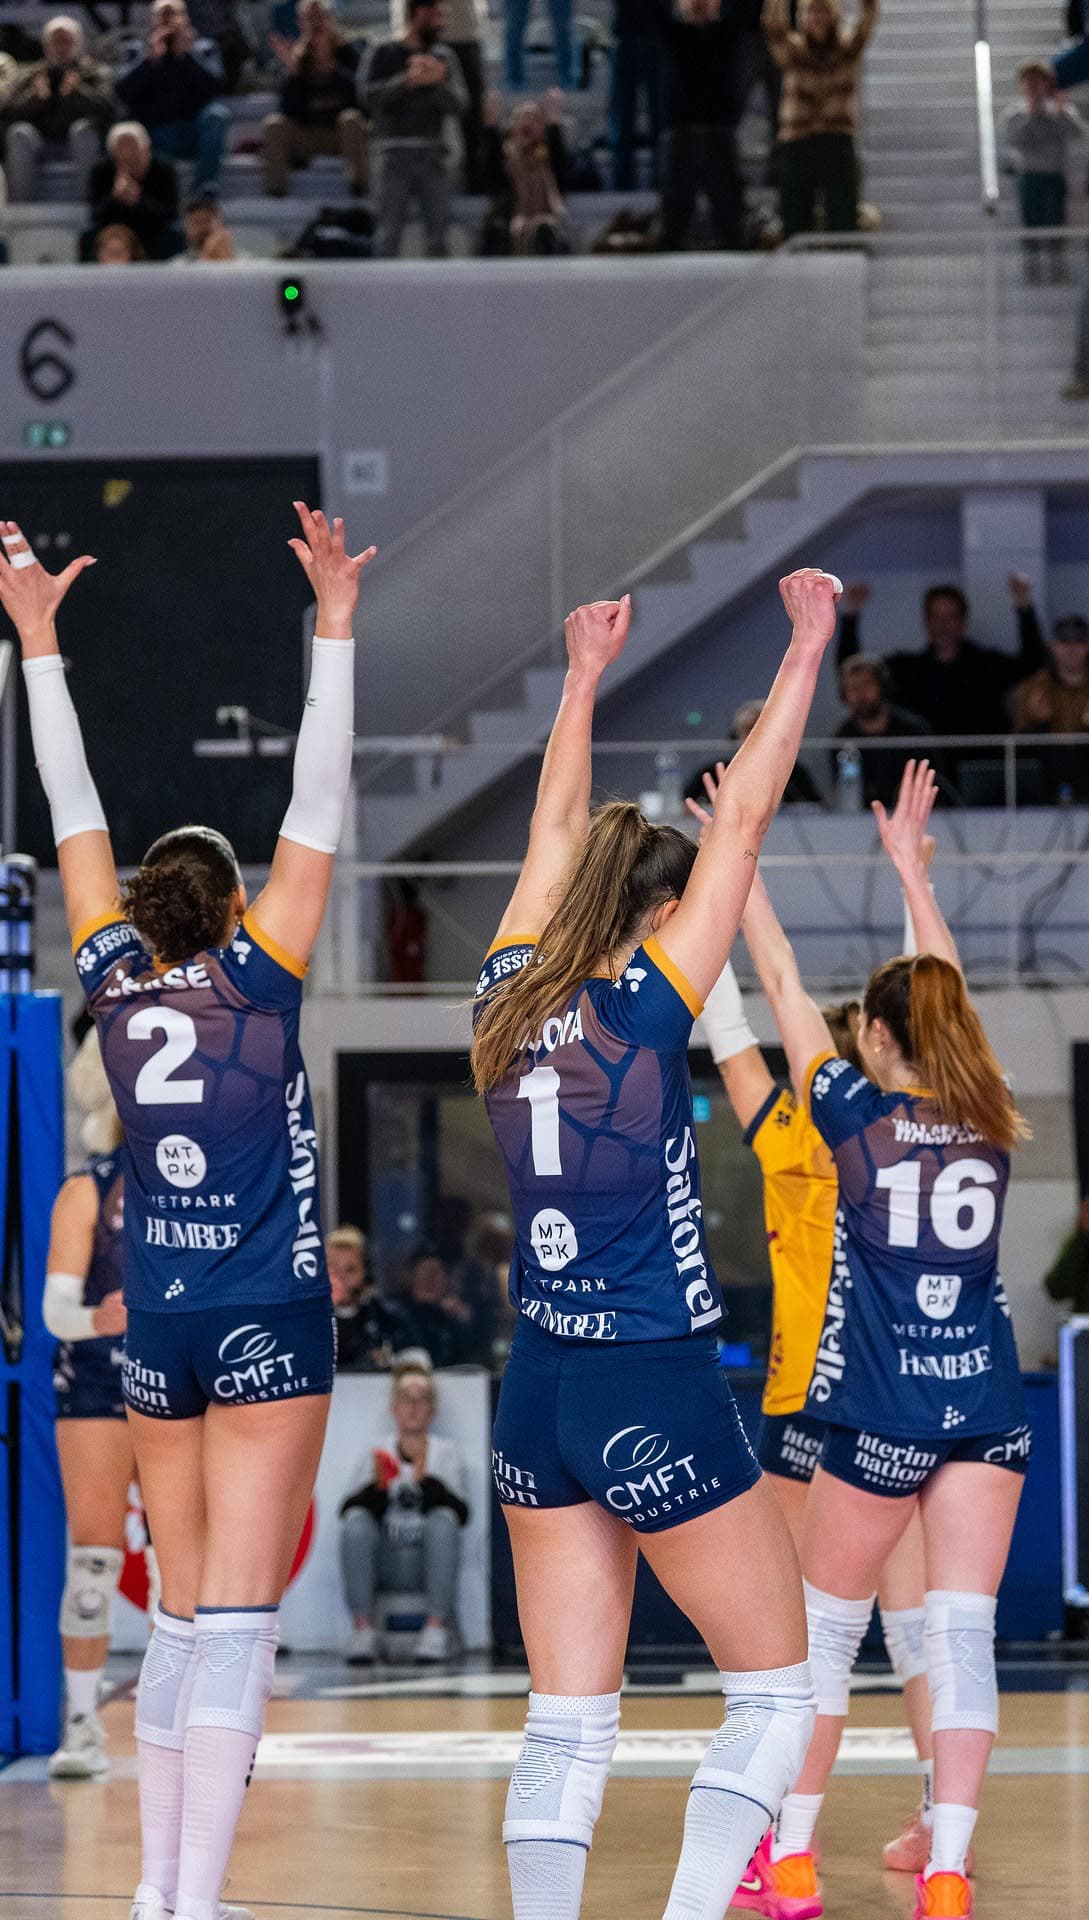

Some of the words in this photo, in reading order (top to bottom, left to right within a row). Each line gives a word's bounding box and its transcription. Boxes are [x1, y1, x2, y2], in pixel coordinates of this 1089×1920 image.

[20, 318, 75, 402] 6
[127, 1006, 204, 1105] 2
[516, 1066, 561, 1176] 1
[164, 1146, 192, 1159] MT
[168, 1163, 198, 1176] PK
[151, 1193, 237, 1209] ETPARK
[875, 1158, 998, 1250] 16
[538, 1223, 566, 1239] MT
[540, 1243, 570, 1259] PK
[927, 1279, 955, 1291] MT
[926, 1295, 953, 1308] PK
[214, 1353, 294, 1398] CMFT
[606, 1454, 696, 1510] CMFT
